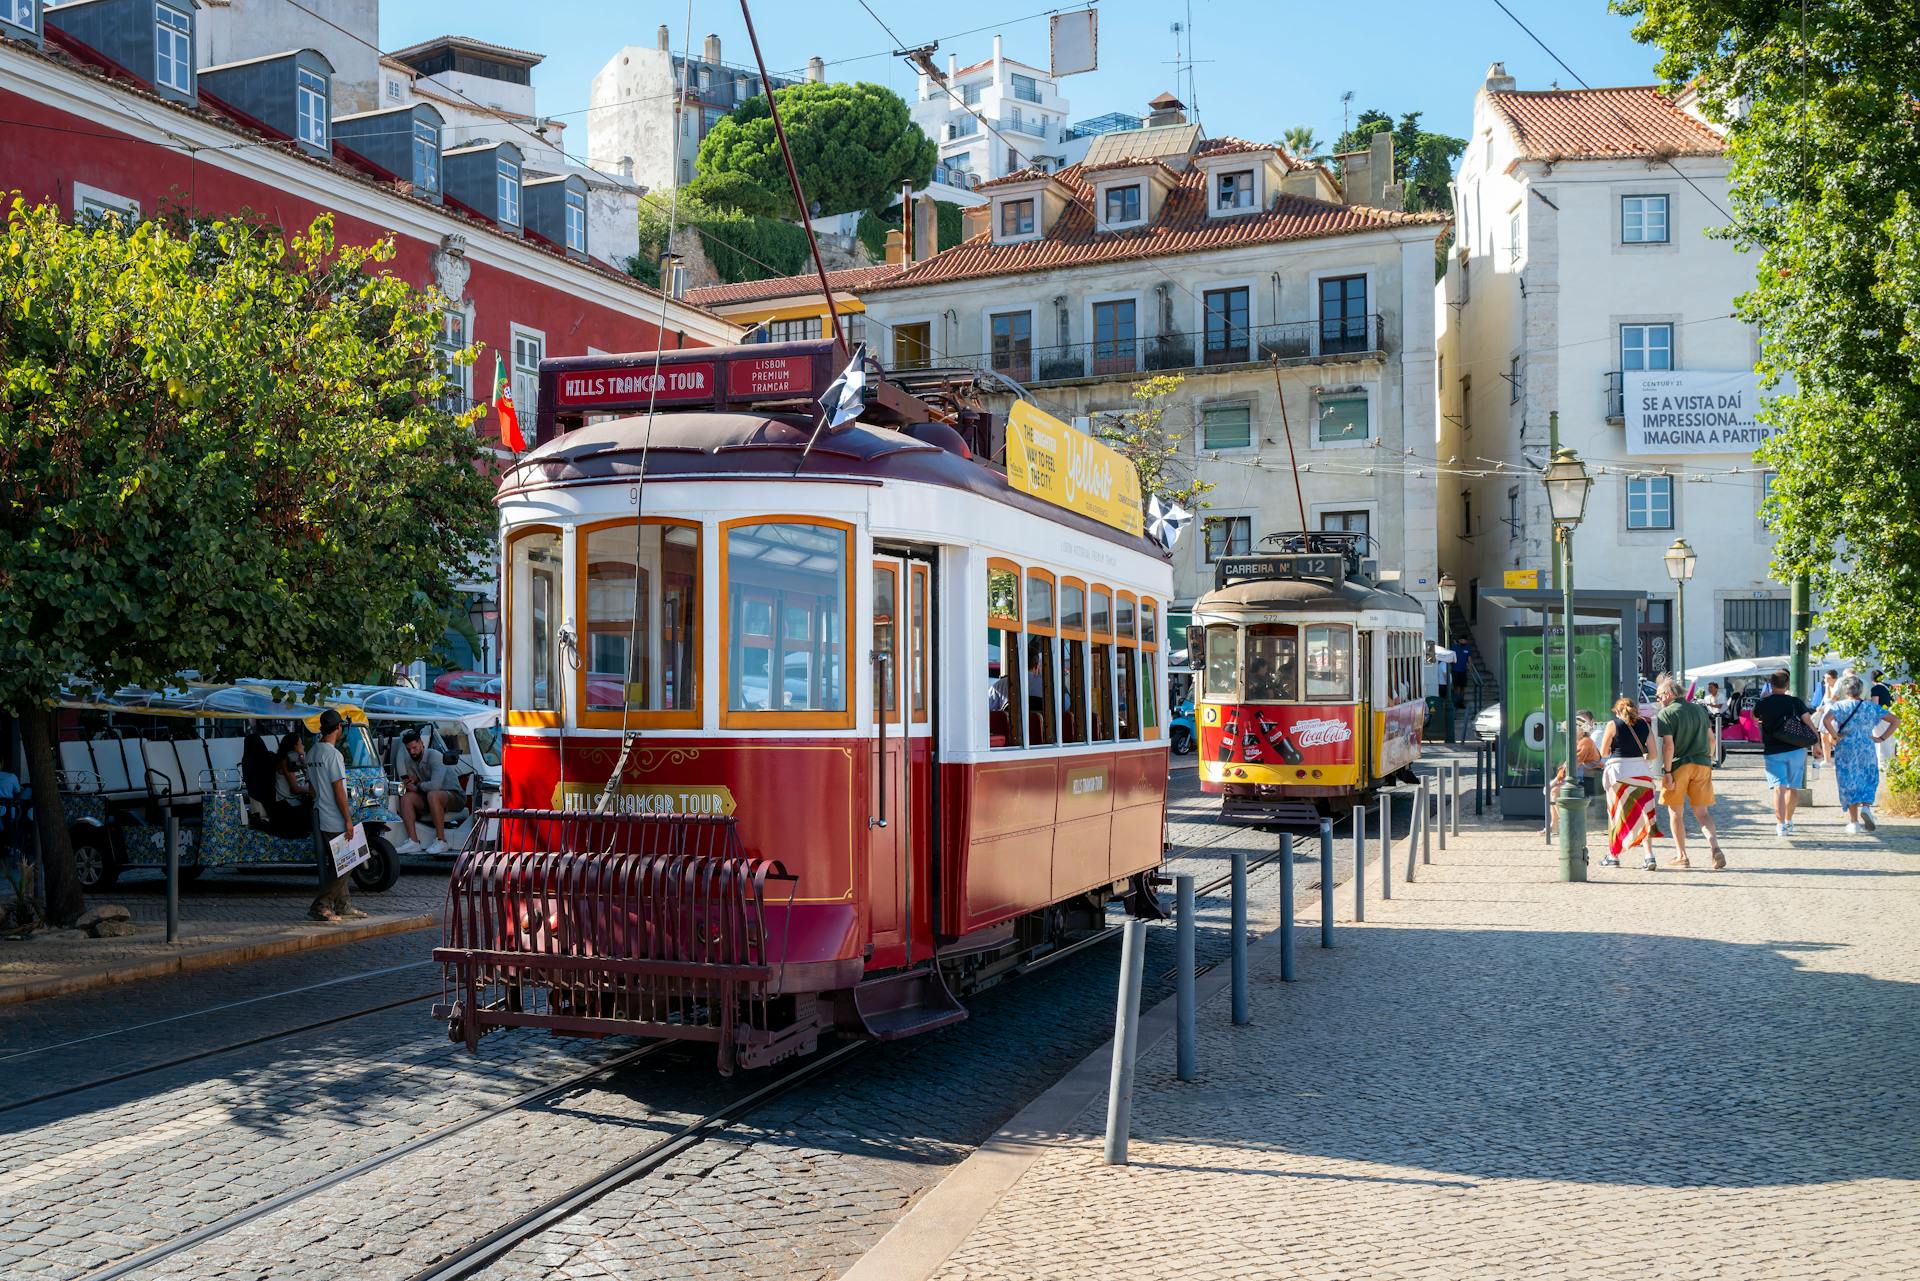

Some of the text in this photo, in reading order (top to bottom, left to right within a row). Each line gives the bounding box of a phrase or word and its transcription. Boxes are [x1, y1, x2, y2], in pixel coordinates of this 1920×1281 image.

[755, 360, 786, 370] LISBON
[566, 372, 705, 397] HILLS TRAMCAR TOUR
[752, 371, 790, 381] PREMIUM
[752, 382, 789, 392] TRAMCAR
[1642, 390, 1741, 411] SE A VISTA DAÍ
[1023, 424, 1034, 443] THE
[1644, 430, 1706, 445] IMAGINA
[1709, 430, 1720, 444] A
[1723, 428, 1769, 443] PARTIR
[1038, 451, 1045, 467] TO
[1045, 455, 1056, 472] FEEL
[1064, 431, 1112, 502] Yellow
[1031, 467, 1040, 486] THE
[630, 487, 638, 505] 9
[1225, 563, 1274, 575] CARREIRA
[1307, 559, 1326, 573] 12
[608, 794, 674, 813] RAMCAR
[679, 794, 723, 813] TOUR
